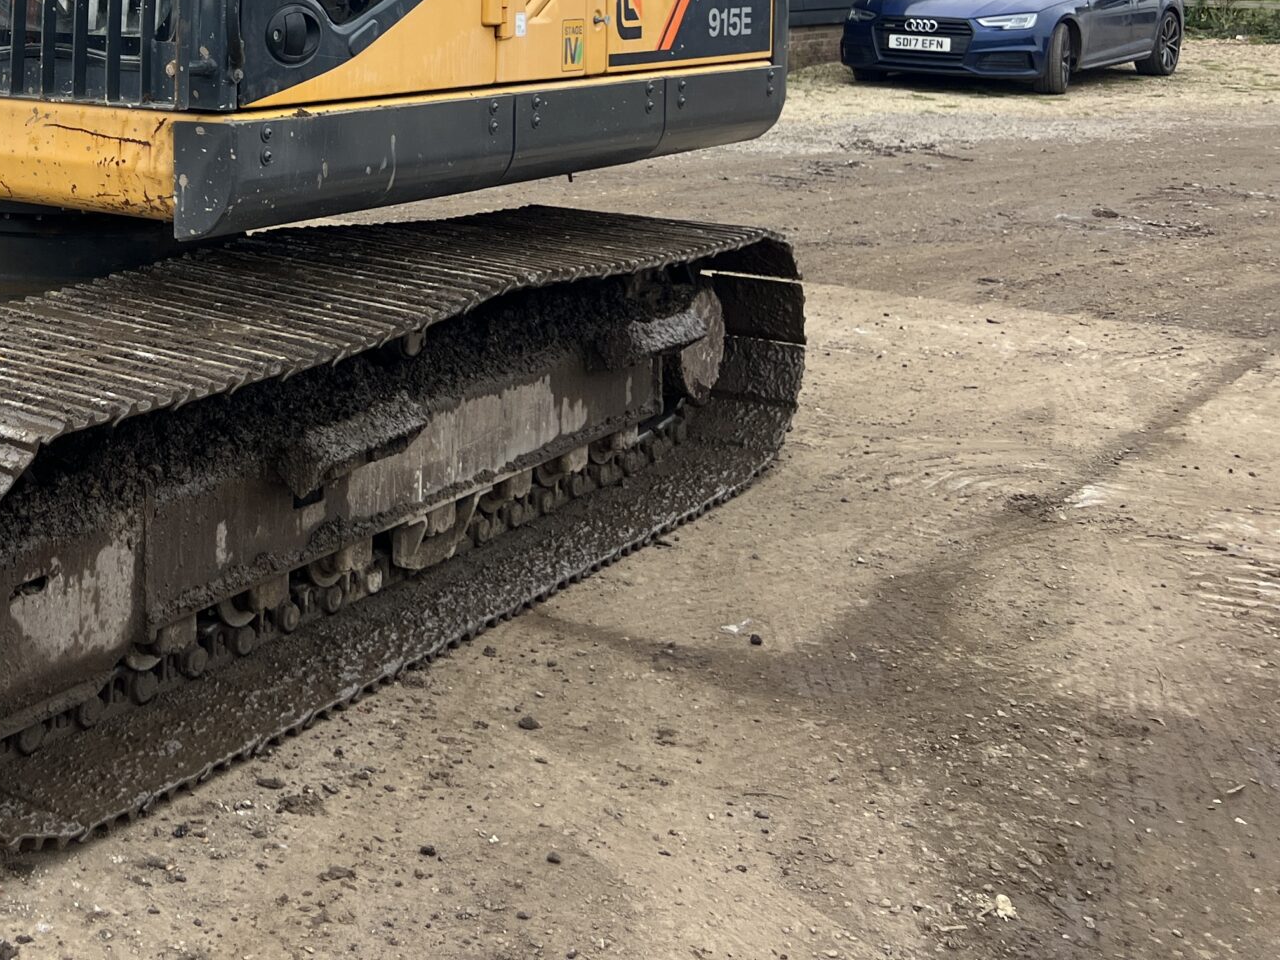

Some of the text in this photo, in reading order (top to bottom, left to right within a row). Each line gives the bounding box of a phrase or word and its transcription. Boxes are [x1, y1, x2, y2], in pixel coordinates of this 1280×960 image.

[708, 6, 752, 38] 915E
[564, 25, 583, 36] STAGE
[895, 36, 944, 50] SD17 EFN
